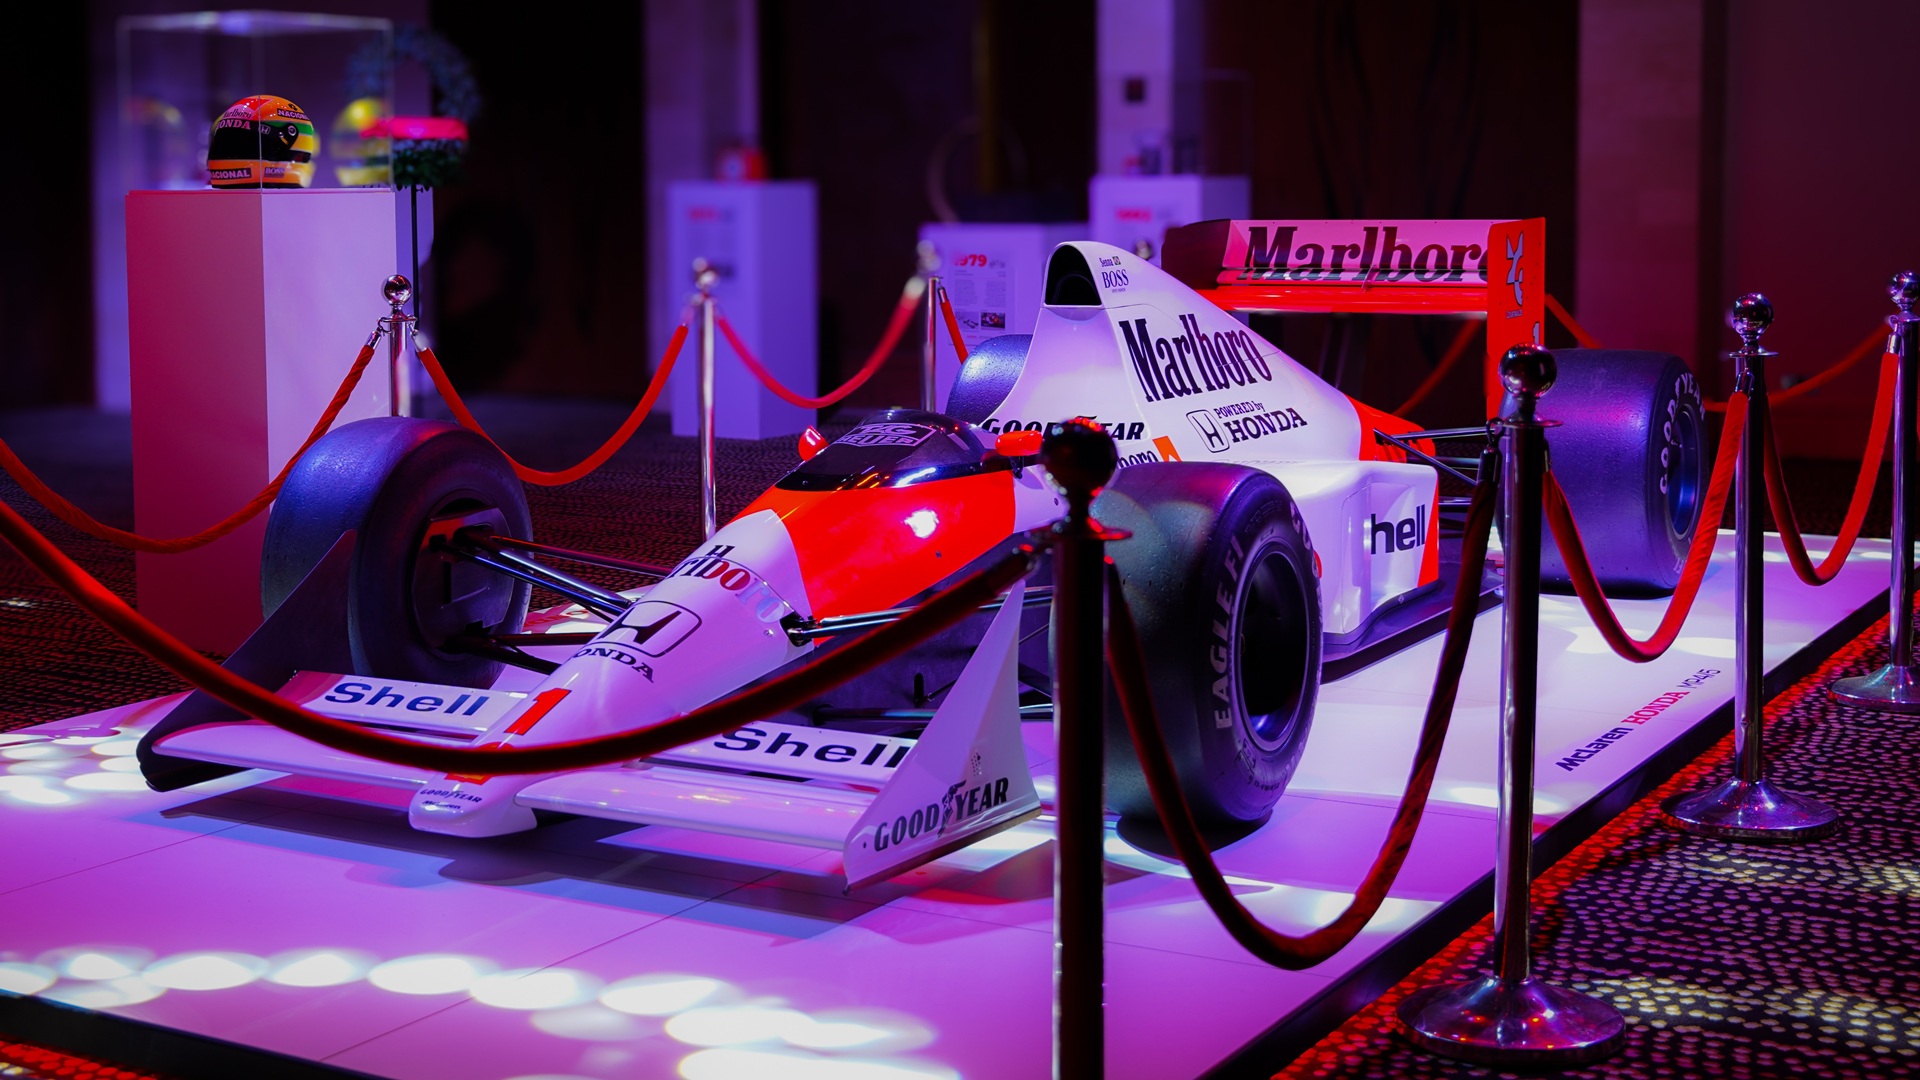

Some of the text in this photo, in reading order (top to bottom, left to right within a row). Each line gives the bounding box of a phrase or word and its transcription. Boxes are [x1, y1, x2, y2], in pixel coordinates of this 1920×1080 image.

[217, 119, 251, 129] ONDA
[1101, 269, 1129, 288] BOSS
[1118, 313, 1272, 402] Marlboro
[1213, 400, 1265, 419] POWERED by
[1223, 407, 1307, 443] HONDA
[666, 545, 785, 623] rlboro
[574, 647, 654, 683] ONDA
[1210, 582, 1233, 729] EAGLE
[325, 682, 490, 716] Shell
[504, 688, 572, 736] 1
[713, 727, 910, 768] Shell
[1555, 726, 1634, 771] McLaren
[1621, 691, 1690, 725] HONDA
